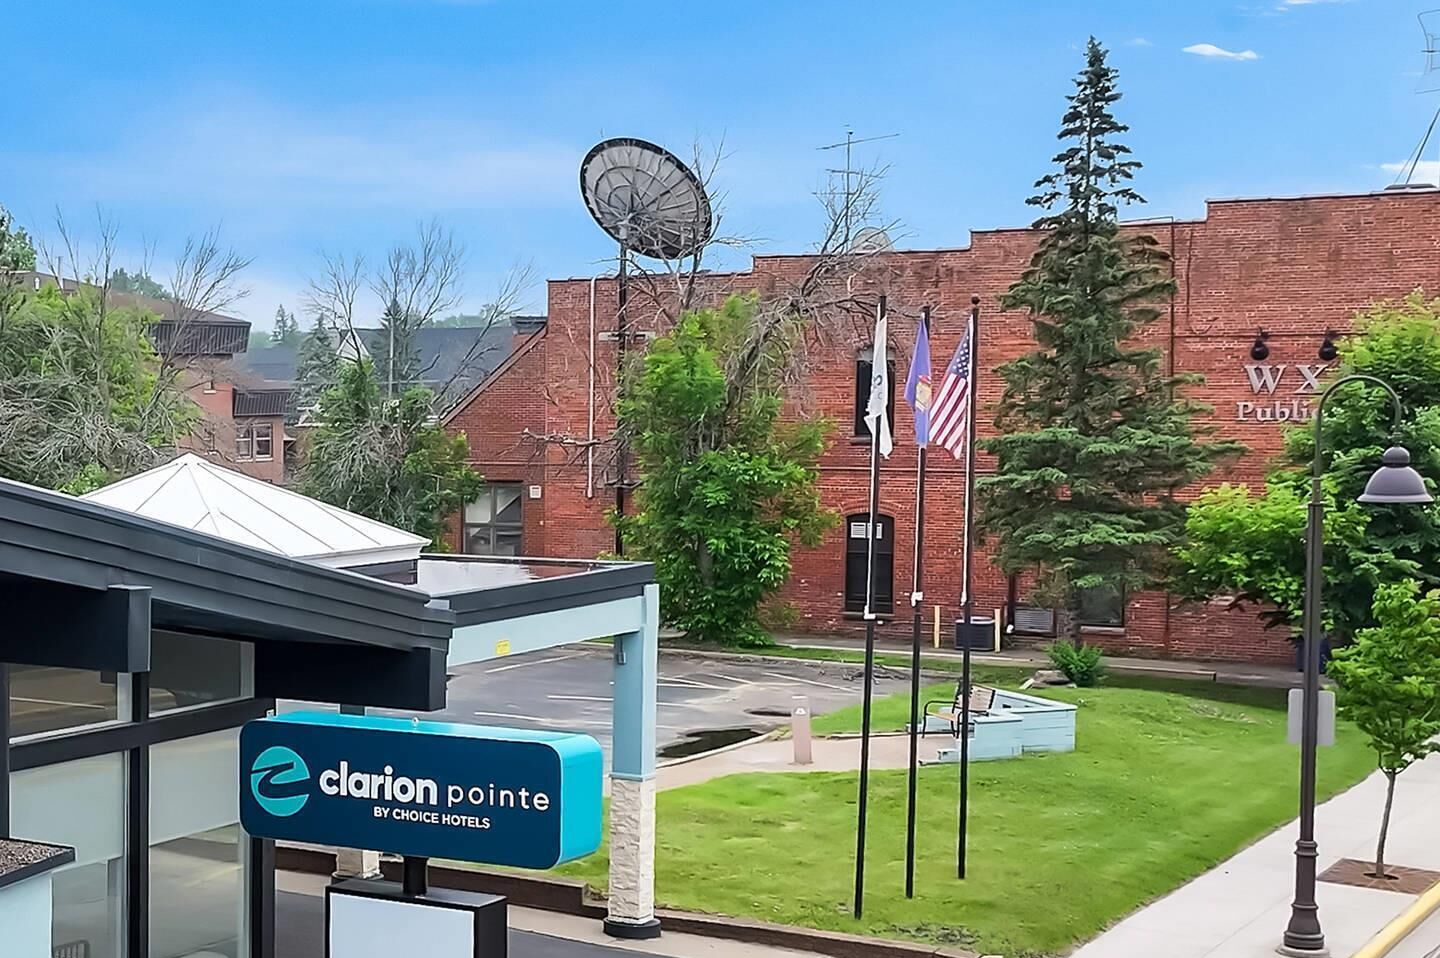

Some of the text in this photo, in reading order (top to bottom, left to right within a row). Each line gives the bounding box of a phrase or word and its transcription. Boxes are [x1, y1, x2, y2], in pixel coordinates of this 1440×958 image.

[319, 761, 550, 811] clarion pointe
[373, 806, 491, 829] BY CHOICE HOTELS
